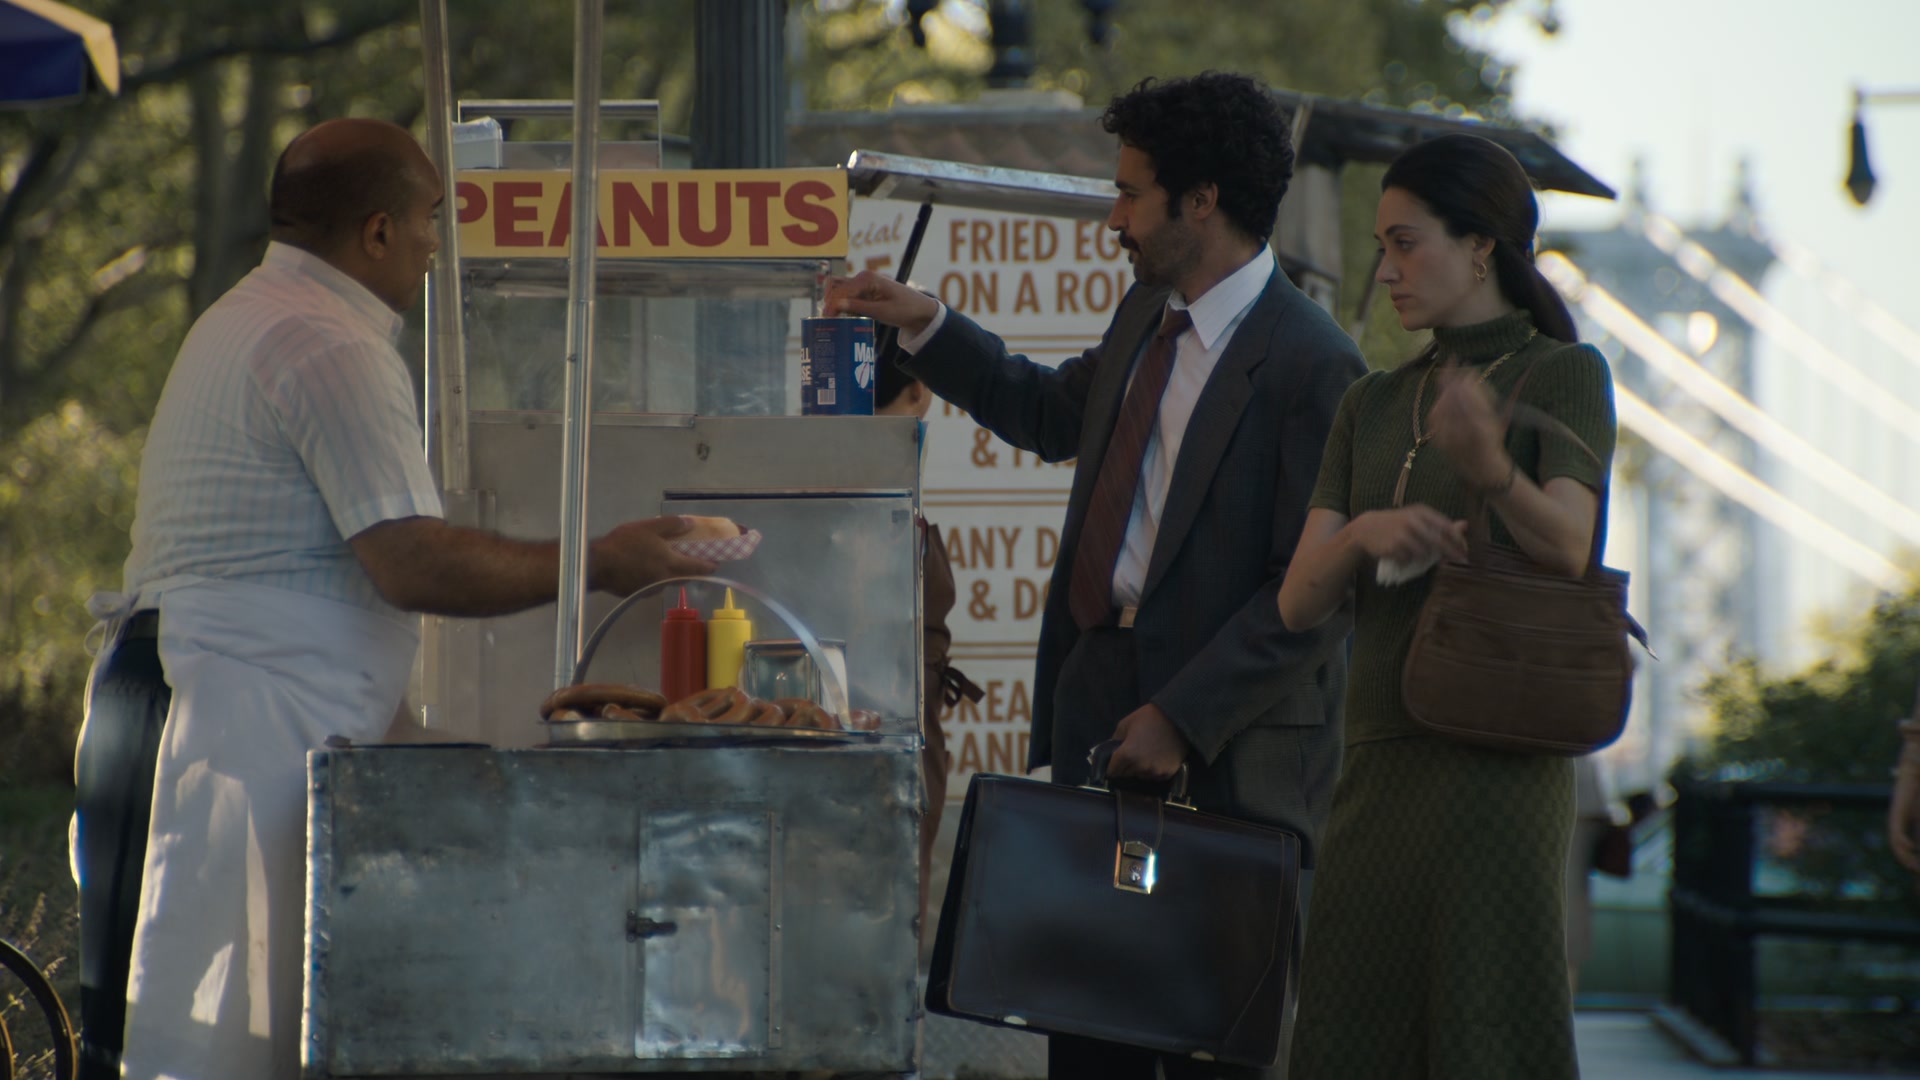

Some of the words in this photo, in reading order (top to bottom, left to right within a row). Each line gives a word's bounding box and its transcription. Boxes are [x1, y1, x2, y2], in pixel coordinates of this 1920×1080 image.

[950, 221, 1058, 263] FRIED
[939, 271, 999, 315] ON
[1013, 271, 1041, 314] A
[946, 527, 1022, 569] ANY
[967, 580, 998, 622] &
